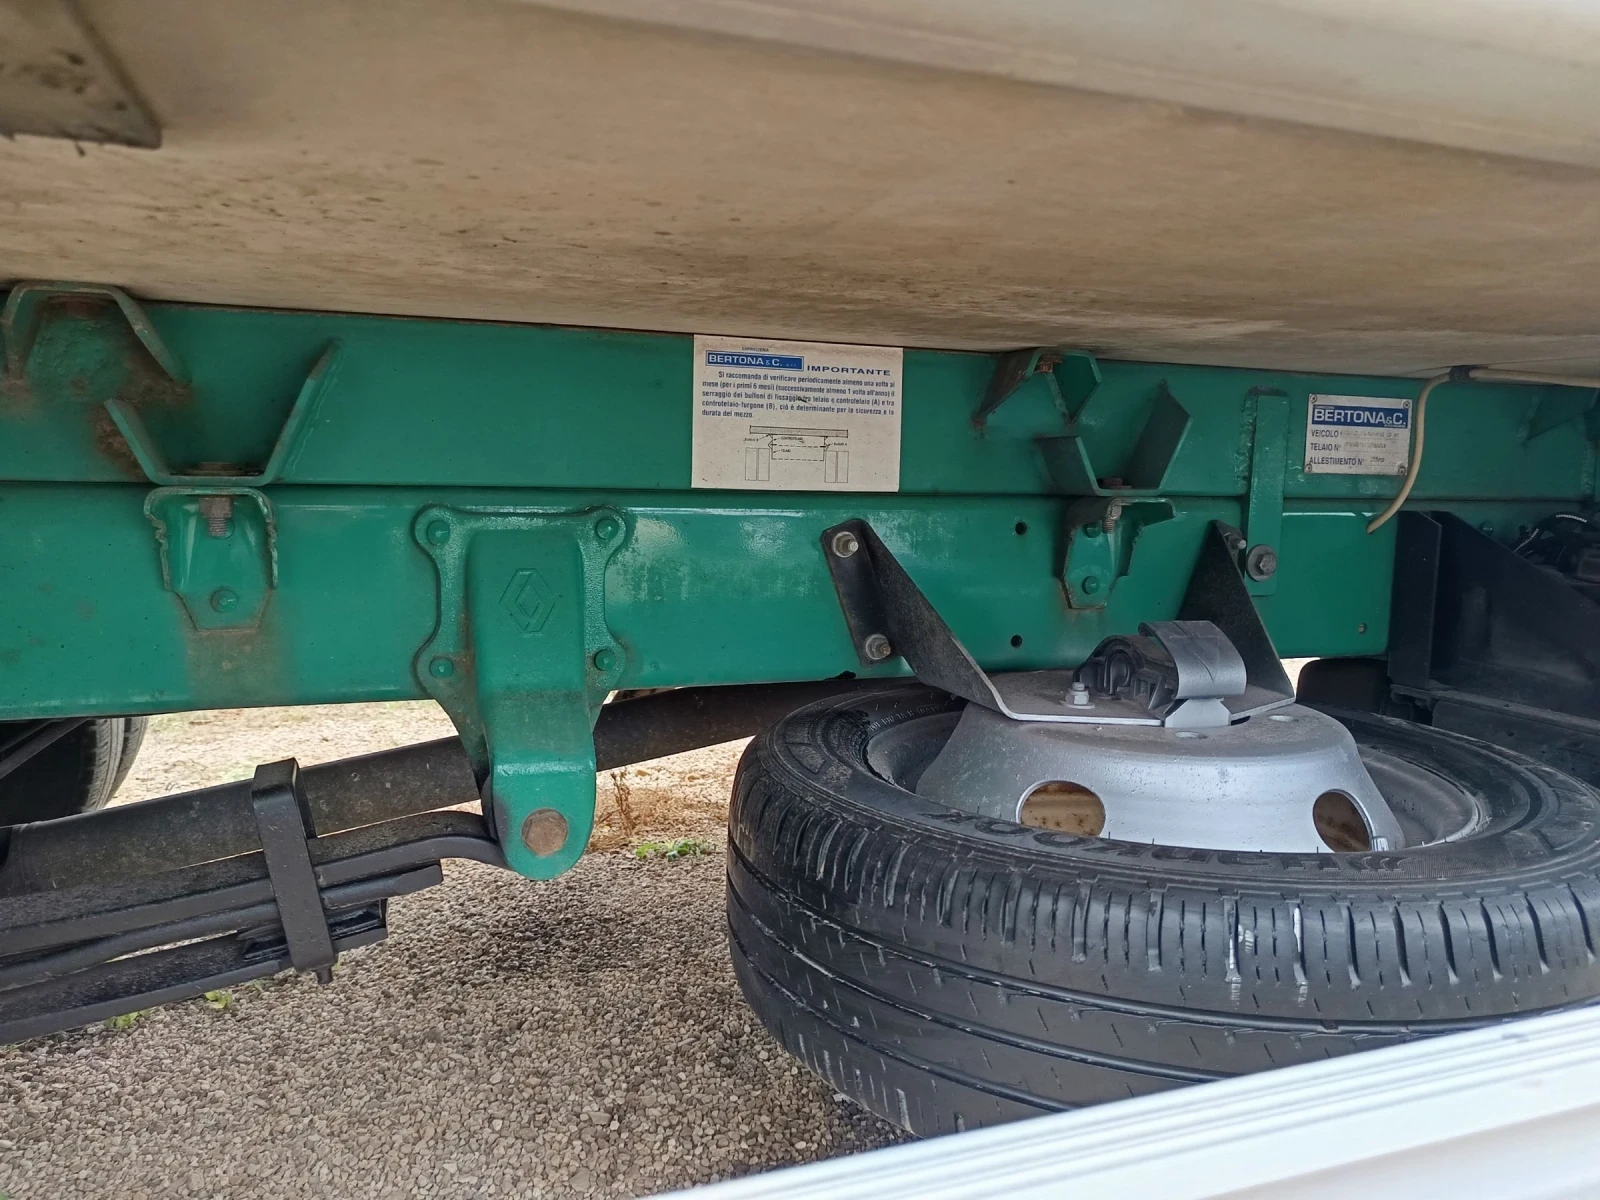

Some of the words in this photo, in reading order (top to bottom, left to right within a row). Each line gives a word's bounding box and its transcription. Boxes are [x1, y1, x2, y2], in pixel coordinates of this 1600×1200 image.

[709, 354, 764, 366] BERTONA
[807, 365, 891, 376] IMPORTANTE
[726, 372, 762, 380] raccomanda
[770, 374, 796, 382] verificare
[798, 376, 841, 385] periodicamente
[702, 390, 732, 398] serraggio
[836, 396, 870, 405] controtelaio
[1311, 430, 1338, 438] VEICOLO
[1310, 456, 1356, 466] ALLESTIMENTO
